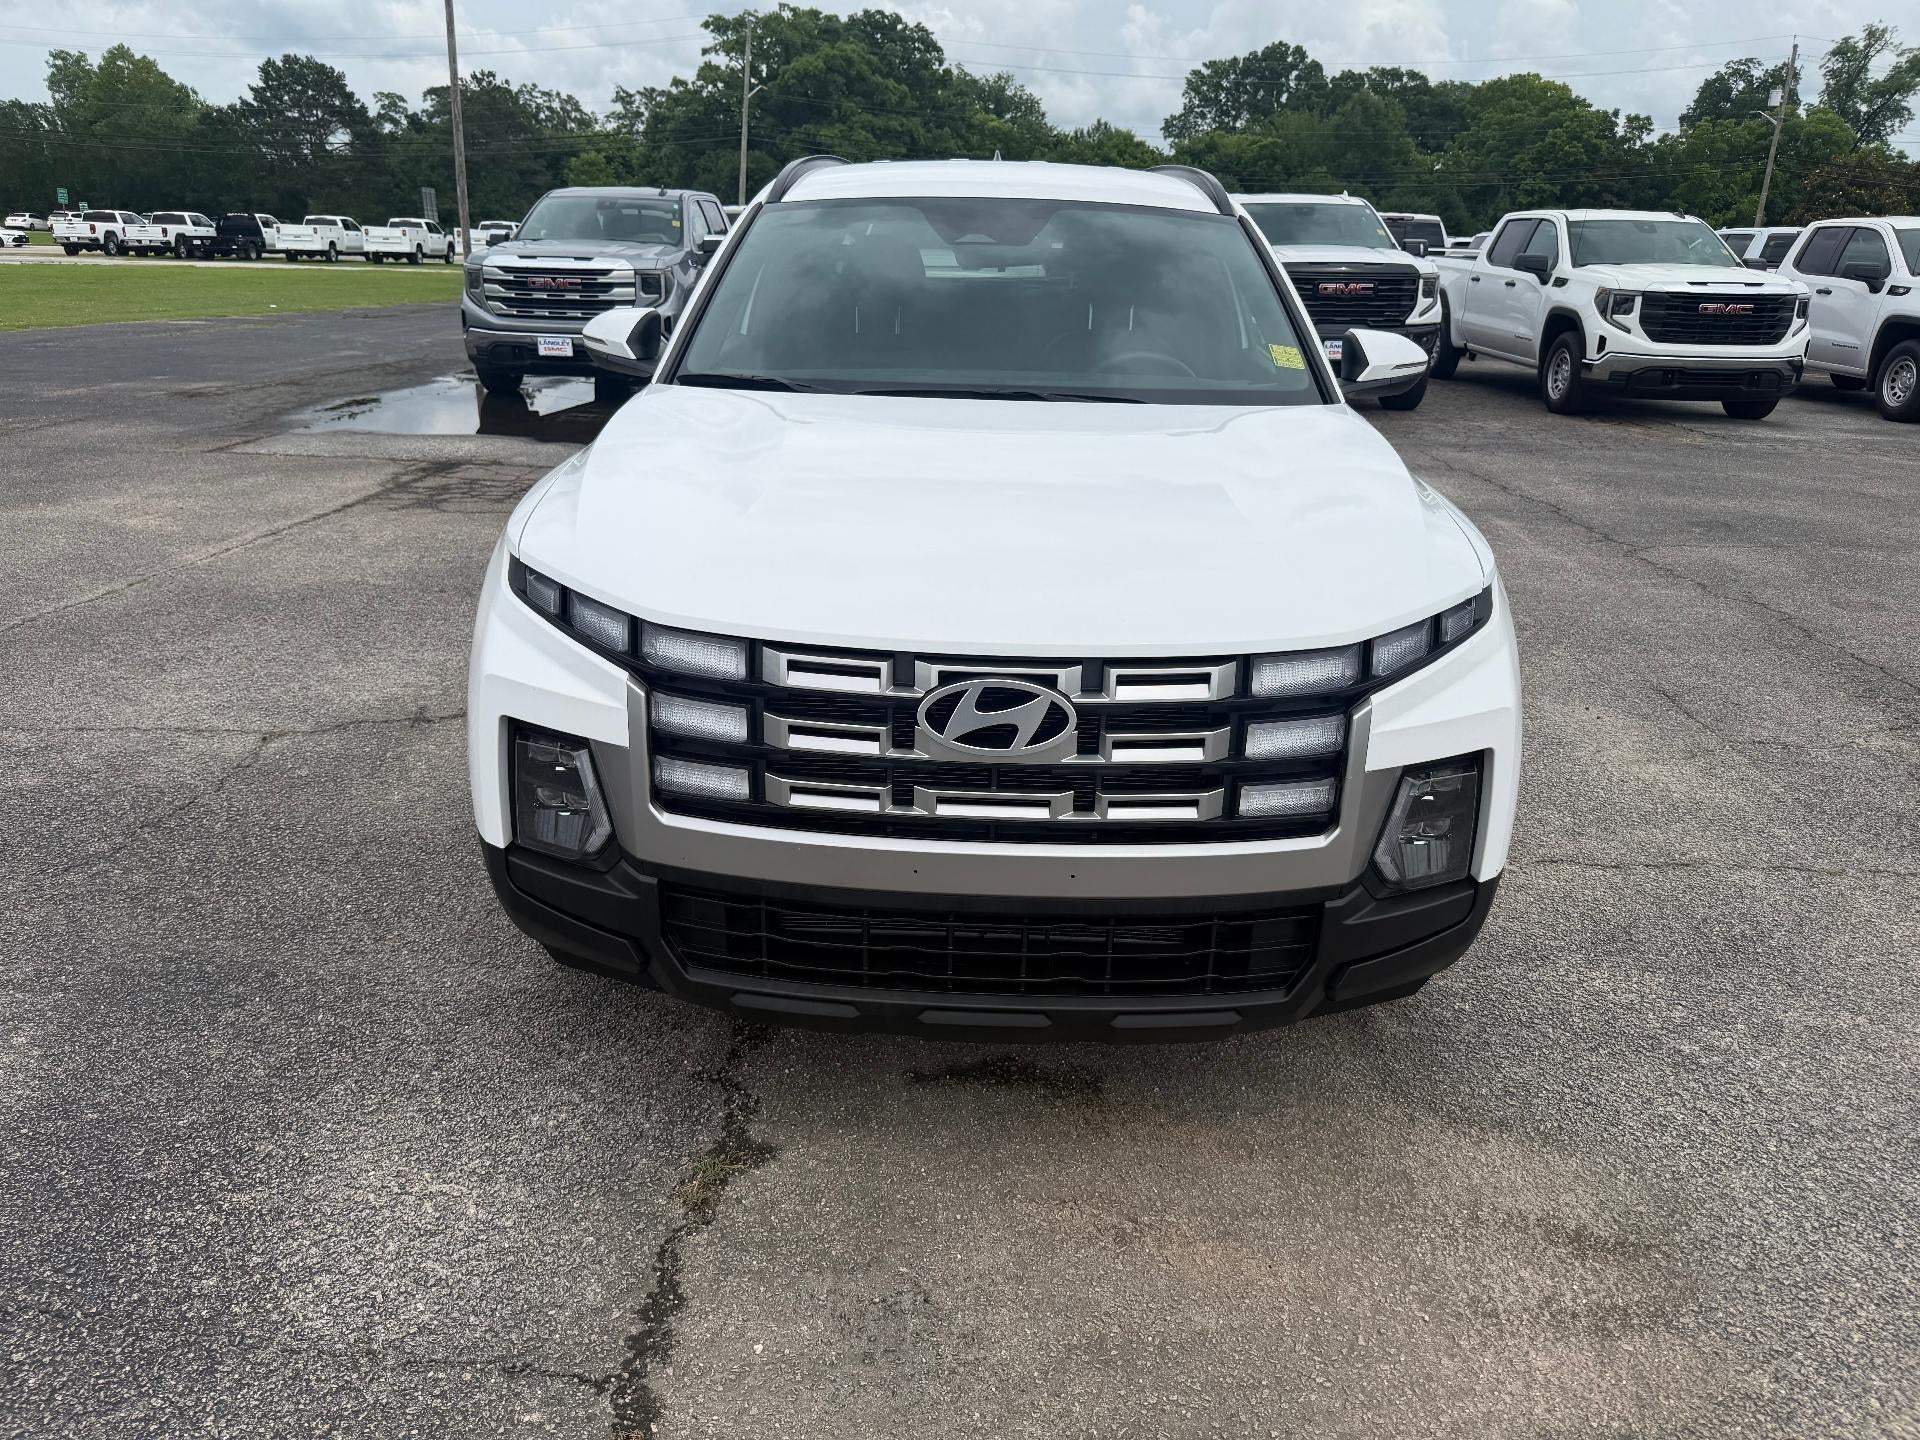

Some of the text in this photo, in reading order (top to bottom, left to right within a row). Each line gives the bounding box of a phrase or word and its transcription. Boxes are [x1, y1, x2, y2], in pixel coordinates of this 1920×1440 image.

[528, 277, 582, 289] GMC
[1319, 283, 1374, 295] GMC
[1699, 303, 1755, 314] GMC
